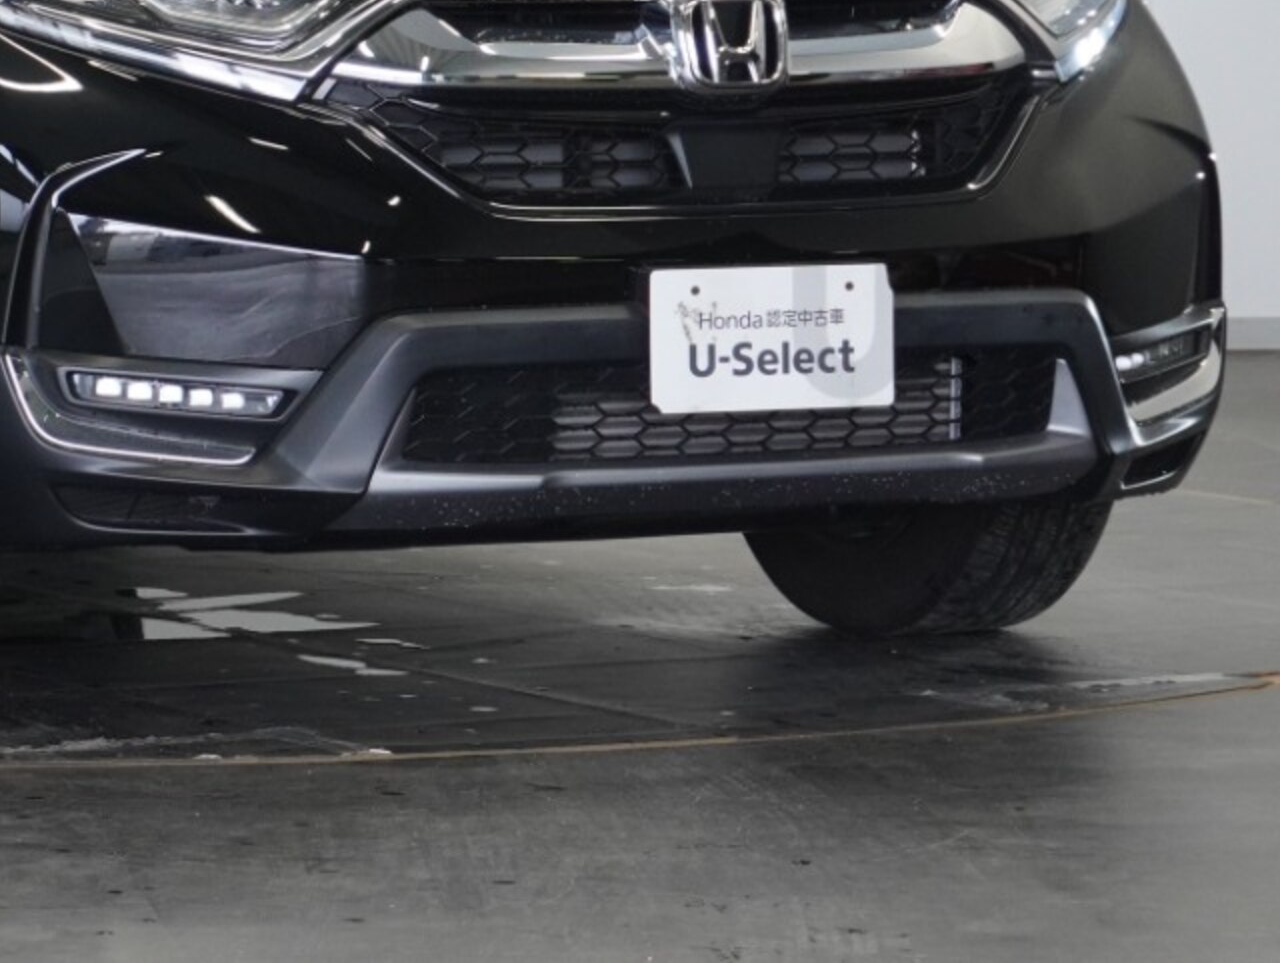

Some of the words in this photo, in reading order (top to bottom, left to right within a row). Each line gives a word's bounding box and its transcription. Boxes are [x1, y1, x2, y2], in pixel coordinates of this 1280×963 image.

[698, 312, 763, 329] Honda
[766, 308, 845, 328] 認定中古車
[688, 339, 855, 378] U-Select
